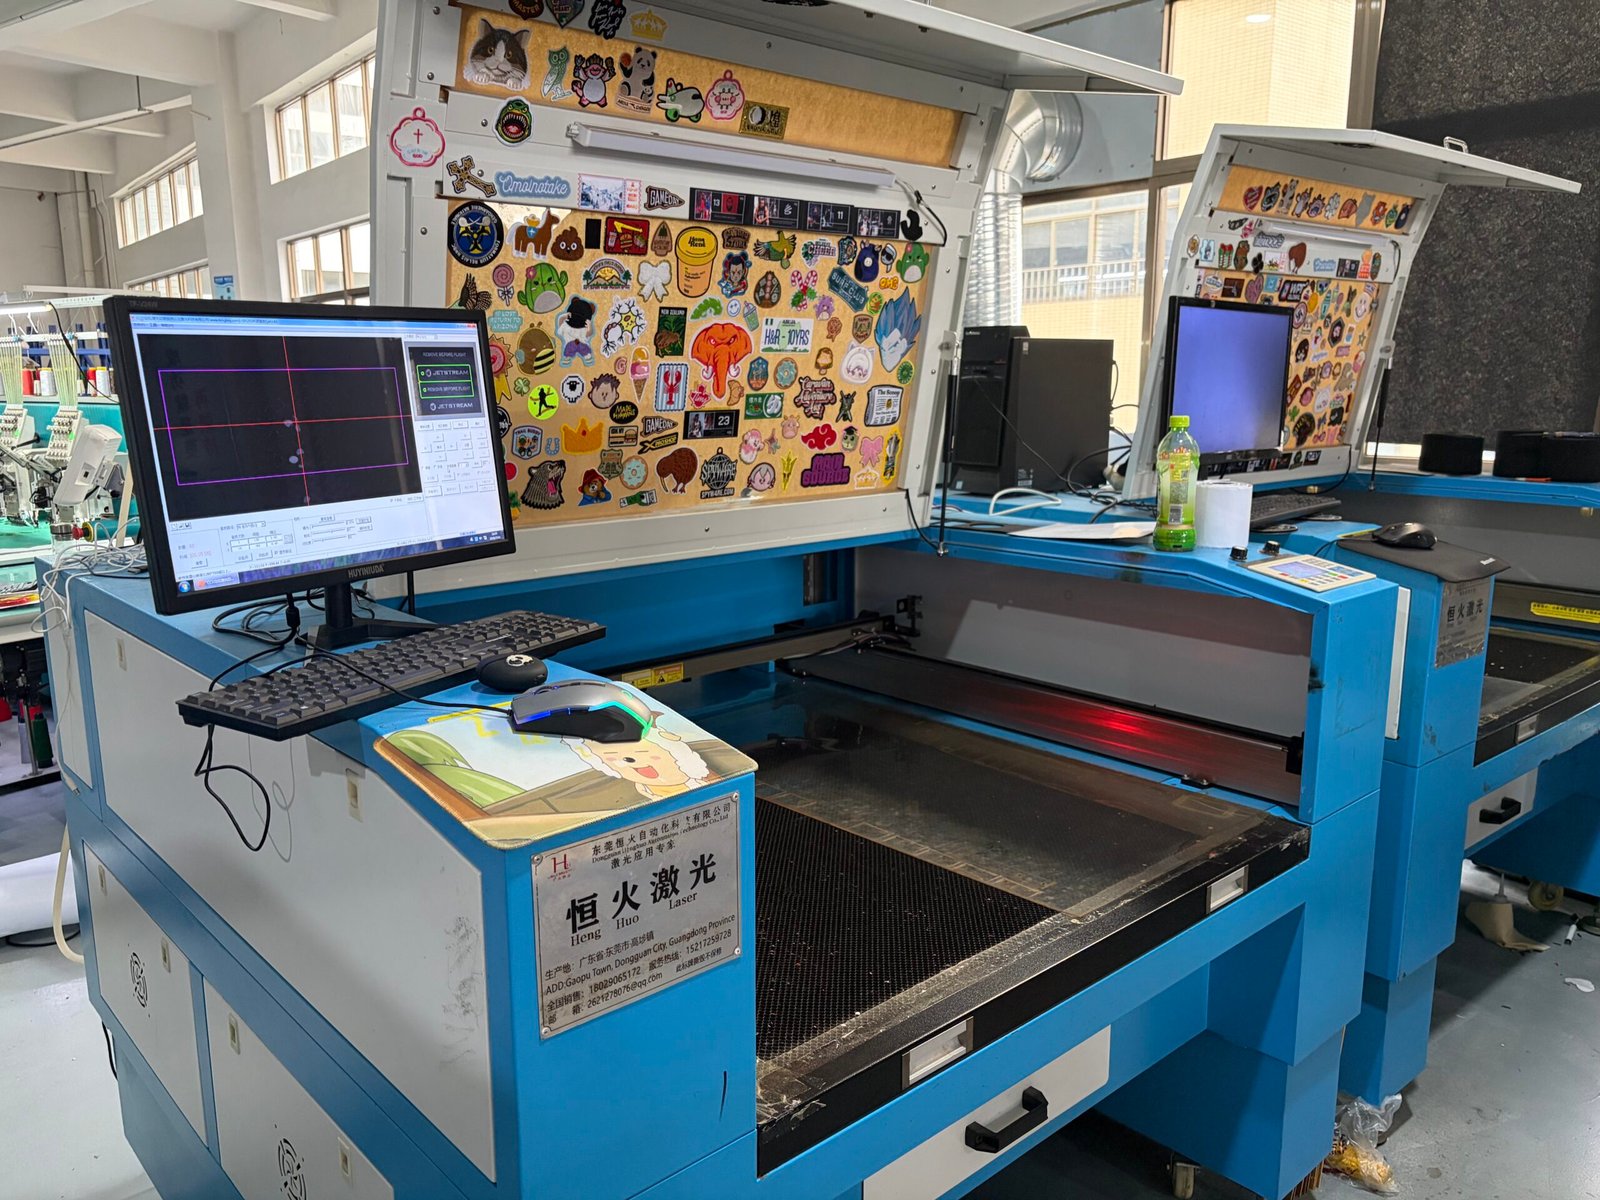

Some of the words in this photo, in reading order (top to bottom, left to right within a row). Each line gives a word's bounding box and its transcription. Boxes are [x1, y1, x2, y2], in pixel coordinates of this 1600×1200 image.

[713, 199, 720, 207] 13
[837, 211, 844, 219] 11
[832, 272, 848, 290] SURF
[848, 287, 865, 304] CLUB
[764, 329, 780, 345] H&R
[788, 329, 810, 345] 10YRS
[646, 418, 674, 432] GAMEDAY
[718, 415, 730, 426] 23
[592, 850, 621, 864] Dongguan
[680, 820, 708, 836] echnology
[611, 839, 676, 870] 激光应用专家
[566, 853, 717, 934] 恒火激光
[571, 929, 602, 946] Heng
[616, 914, 640, 930] Huo
[668, 892, 698, 910] Laser
[592, 963, 614, 978] Town,
[615, 947, 652, 969] Dongguan
[668, 926, 708, 947] Guangdong
[708, 914, 736, 930] Province
[589, 966, 641, 995] 18029065172
[686, 929, 732, 954] 15217259728
